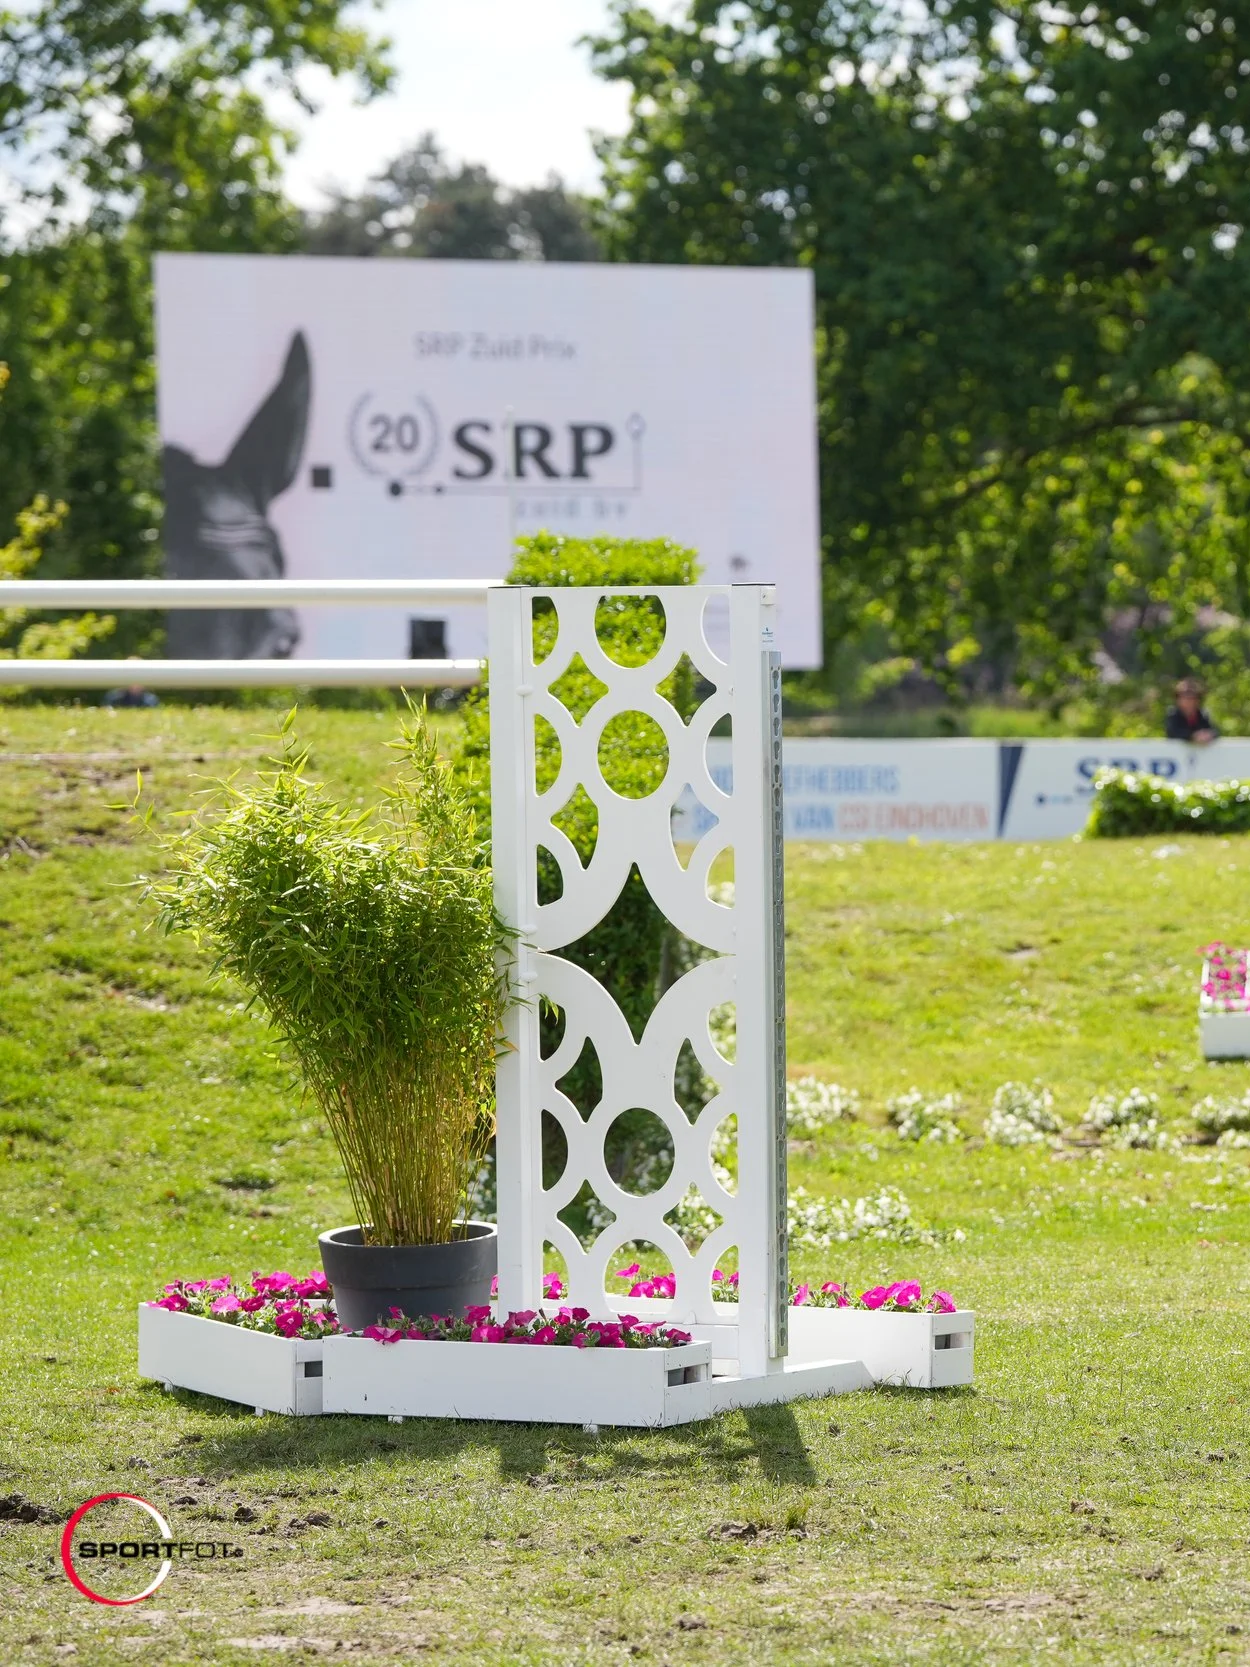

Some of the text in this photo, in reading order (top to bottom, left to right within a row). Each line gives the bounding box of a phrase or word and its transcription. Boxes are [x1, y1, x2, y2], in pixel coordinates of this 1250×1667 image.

[412, 331, 578, 361] SRP Zuid Prix
[369, 414, 420, 451] 20
[453, 419, 614, 480] SRP
[791, 802, 834, 833] VAN
[875, 802, 990, 833] EINDHOVEN
